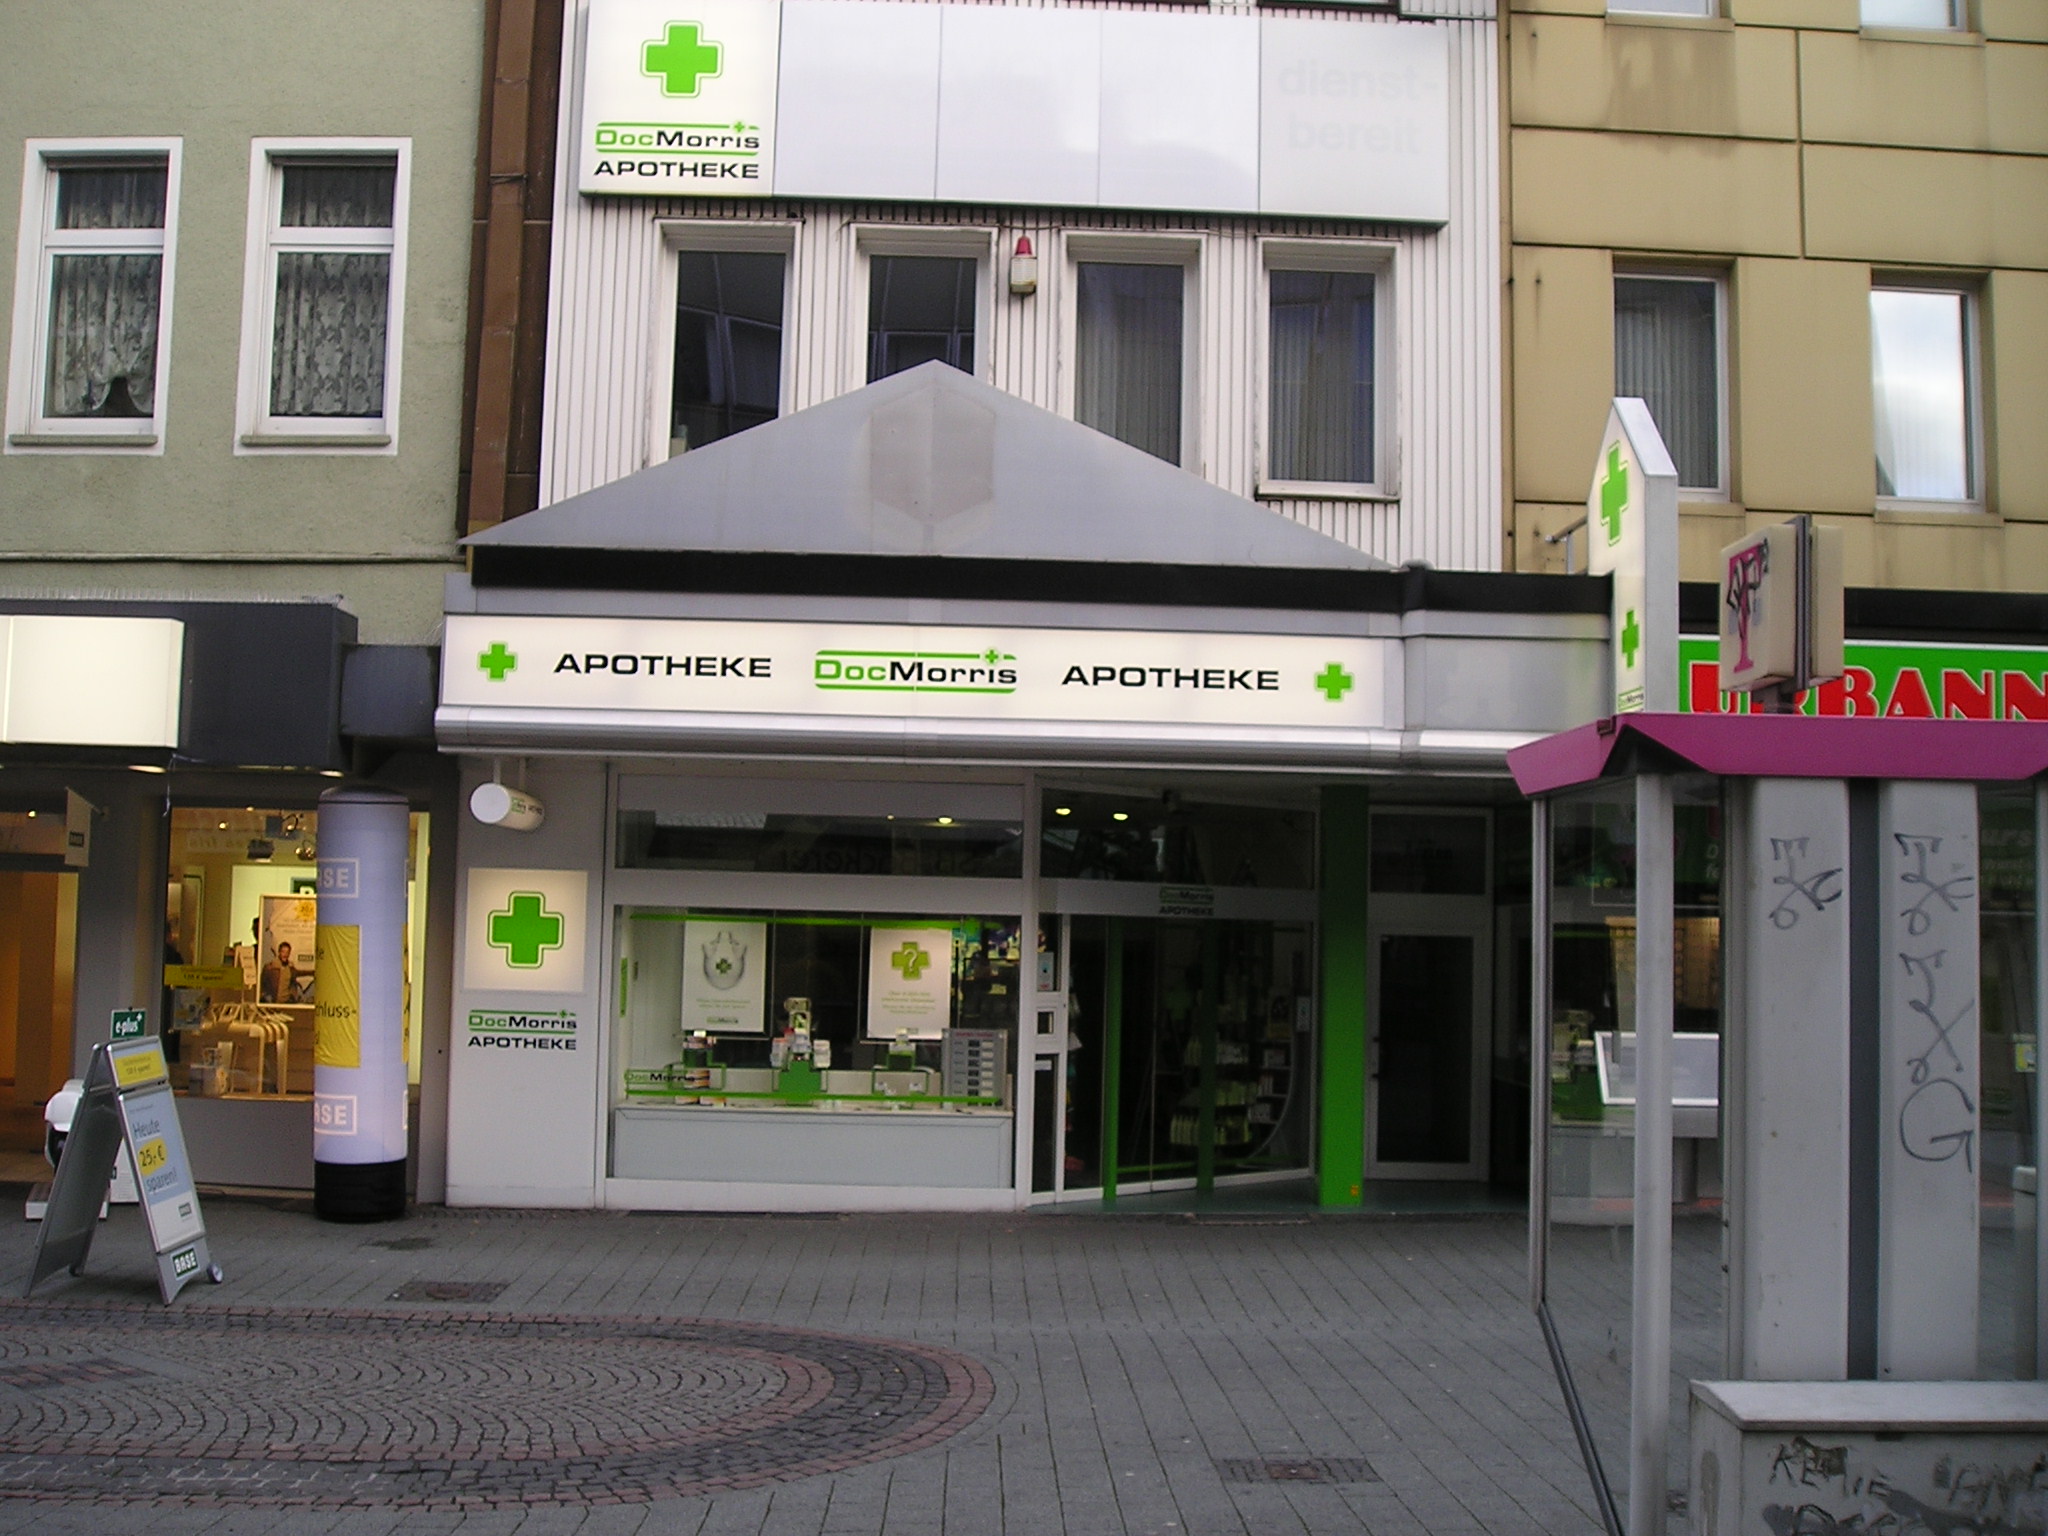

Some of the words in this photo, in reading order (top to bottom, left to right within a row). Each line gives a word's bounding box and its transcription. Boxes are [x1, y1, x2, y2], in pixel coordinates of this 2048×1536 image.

[595, 128, 760, 149] DocMorris
[593, 160, 759, 179] APOTHEKE
[554, 653, 772, 678] APOTHEKE
[814, 659, 1017, 685] DocMorris
[1061, 664, 1280, 691] APOTHEKE
[468, 1014, 577, 1029] DocMorris
[467, 1036, 577, 1050] APOTHEKE
[132, 1118, 161, 1138] Heute
[174, 1250, 197, 1275] BASE
